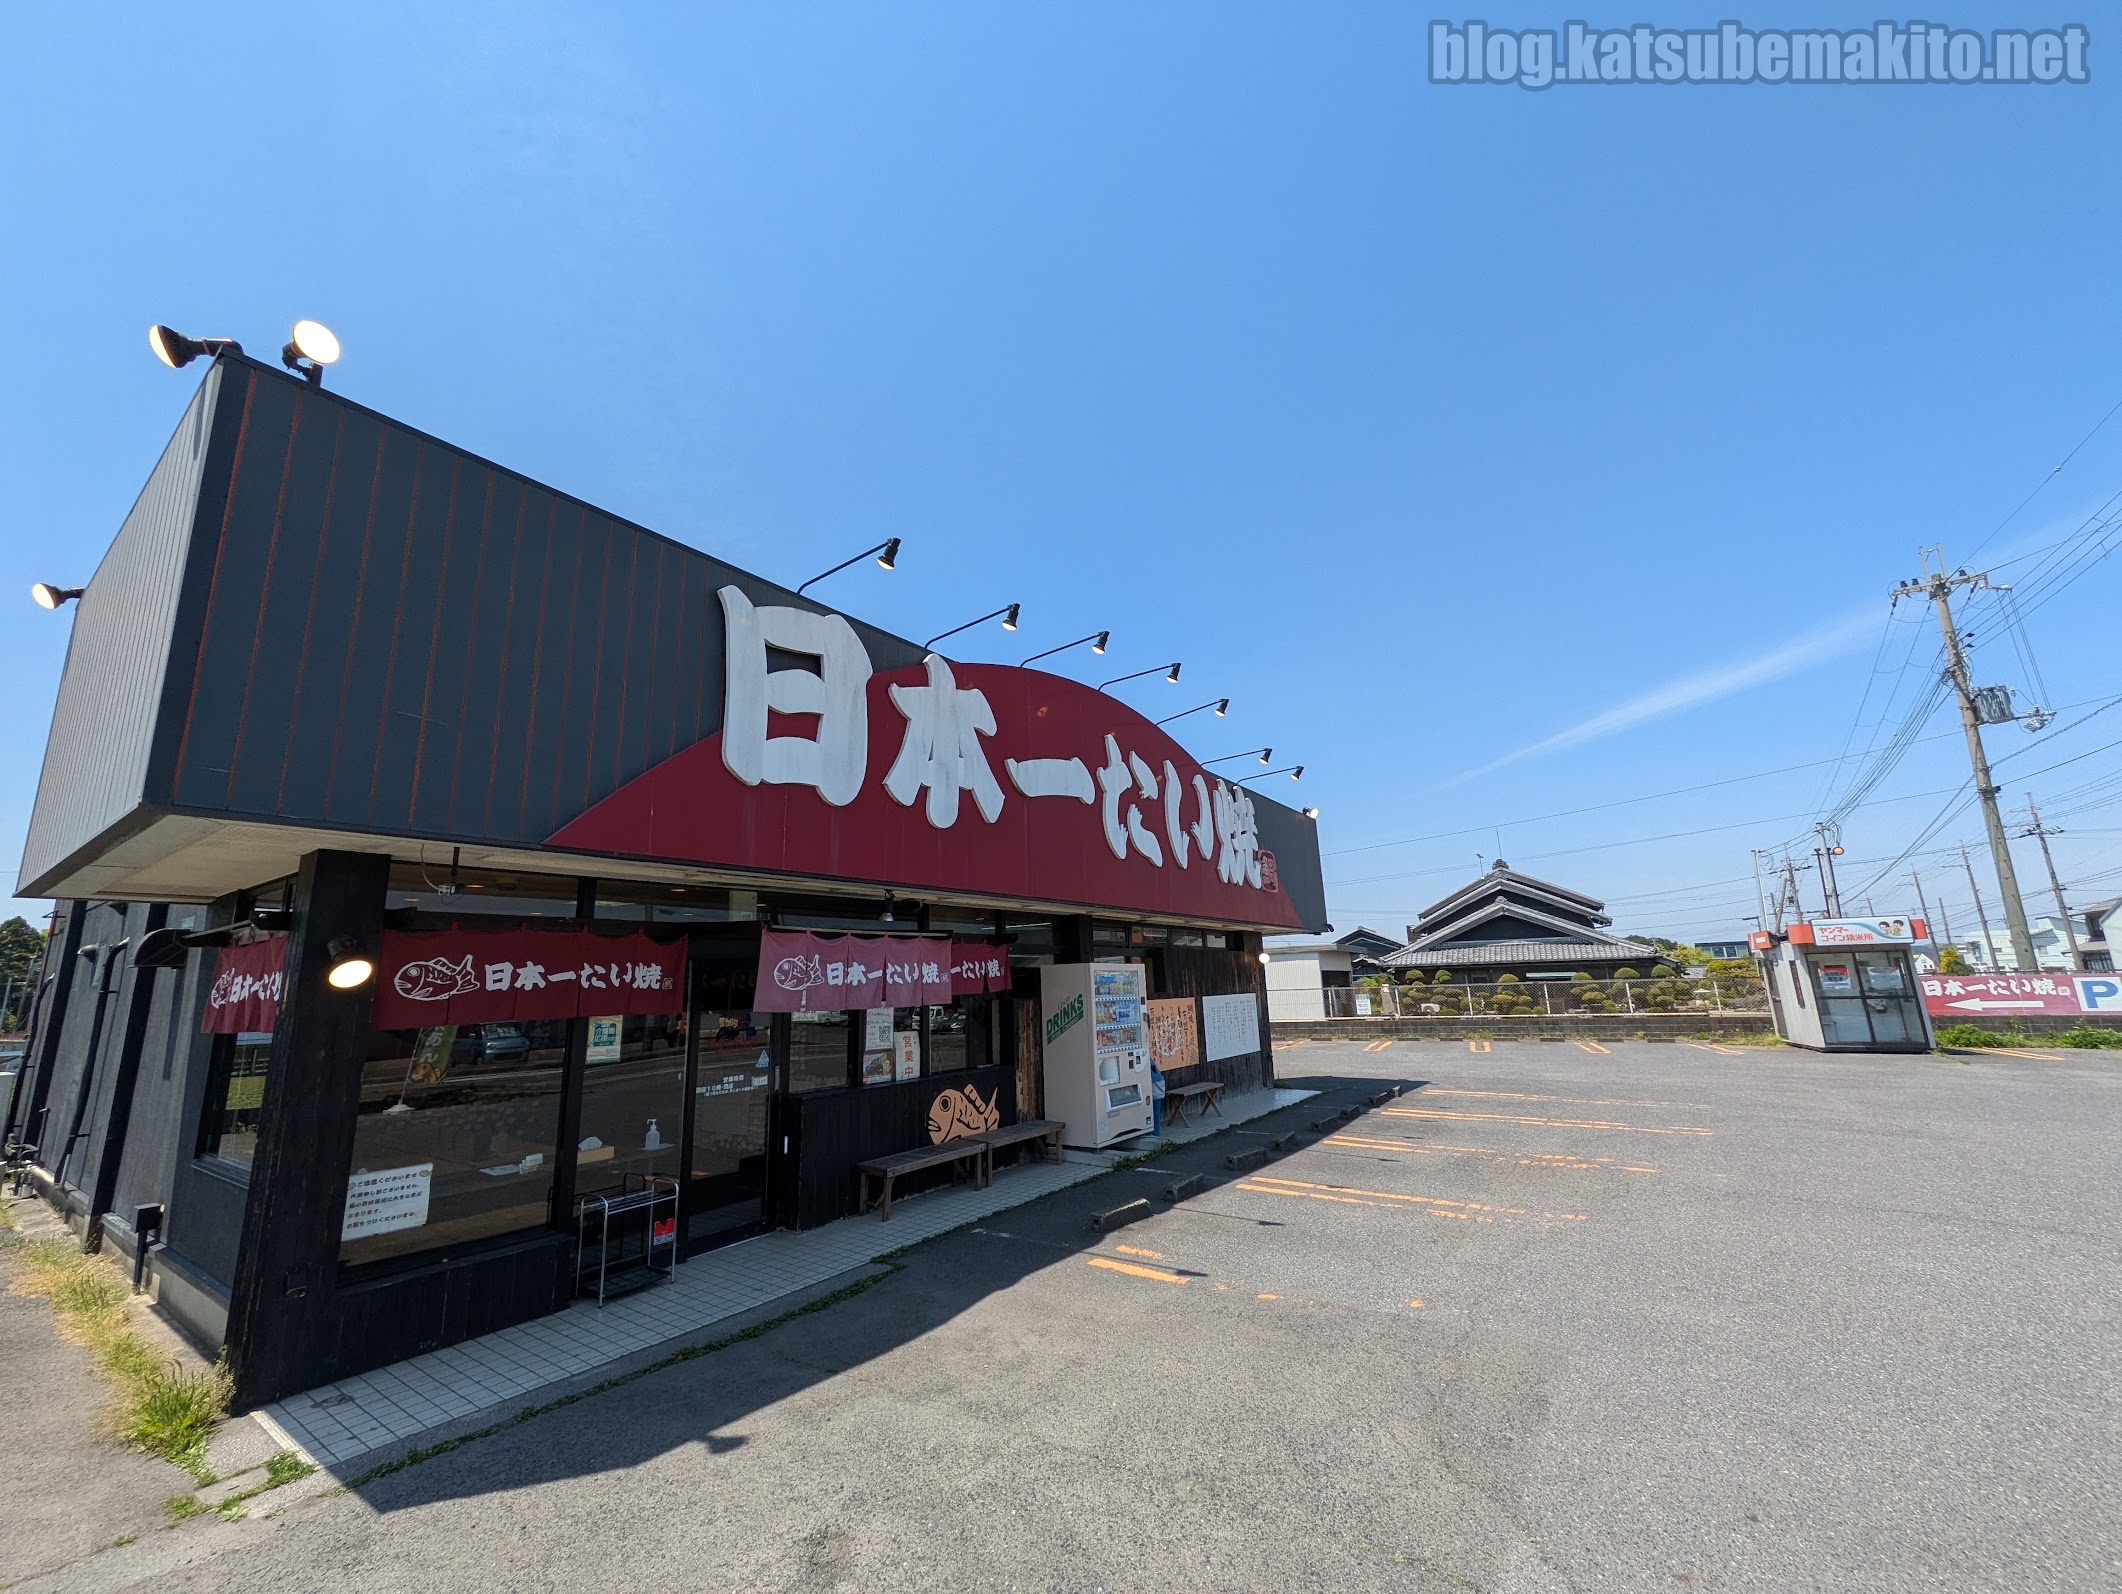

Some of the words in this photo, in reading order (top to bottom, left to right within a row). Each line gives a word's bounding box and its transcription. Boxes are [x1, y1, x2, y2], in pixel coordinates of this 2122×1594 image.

[717, 584, 1262, 889] 日本一たい焼
[1818, 926, 1849, 934] ヤンマー
[1820, 933, 1873, 942] コイン精米所
[484, 960, 664, 992] 日本一たい焼
[826, 961, 941, 987] 日本一たい焼
[1922, 977, 2057, 997] 日本一たい焼
[2080, 980, 2119, 1009] P
[1046, 993, 1084, 1037] DRINKS
[902, 1035, 914, 1078] 営業中
